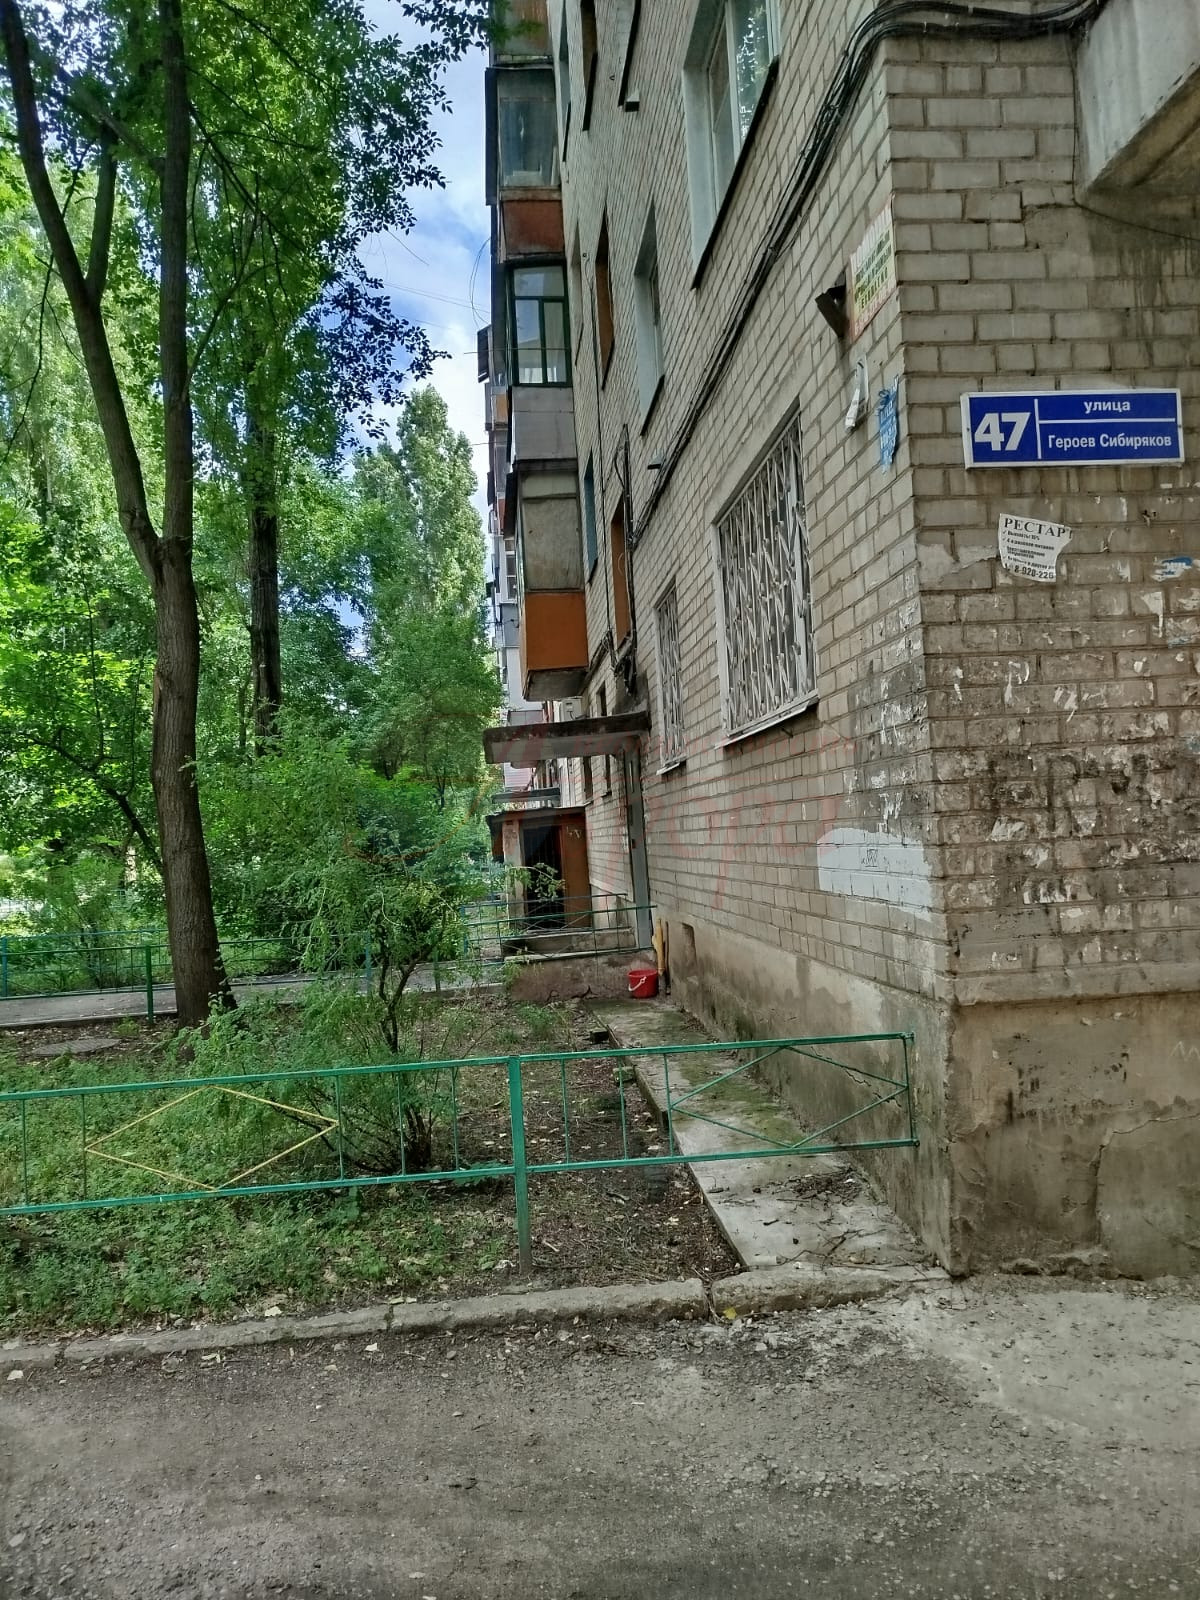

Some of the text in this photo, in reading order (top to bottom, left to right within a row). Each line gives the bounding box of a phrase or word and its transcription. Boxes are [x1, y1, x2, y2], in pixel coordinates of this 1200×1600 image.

[1084, 400, 1130, 414] улица
[974, 411, 1031, 451] 47
[1048, 433, 1172, 451] Героев Сибиряков
